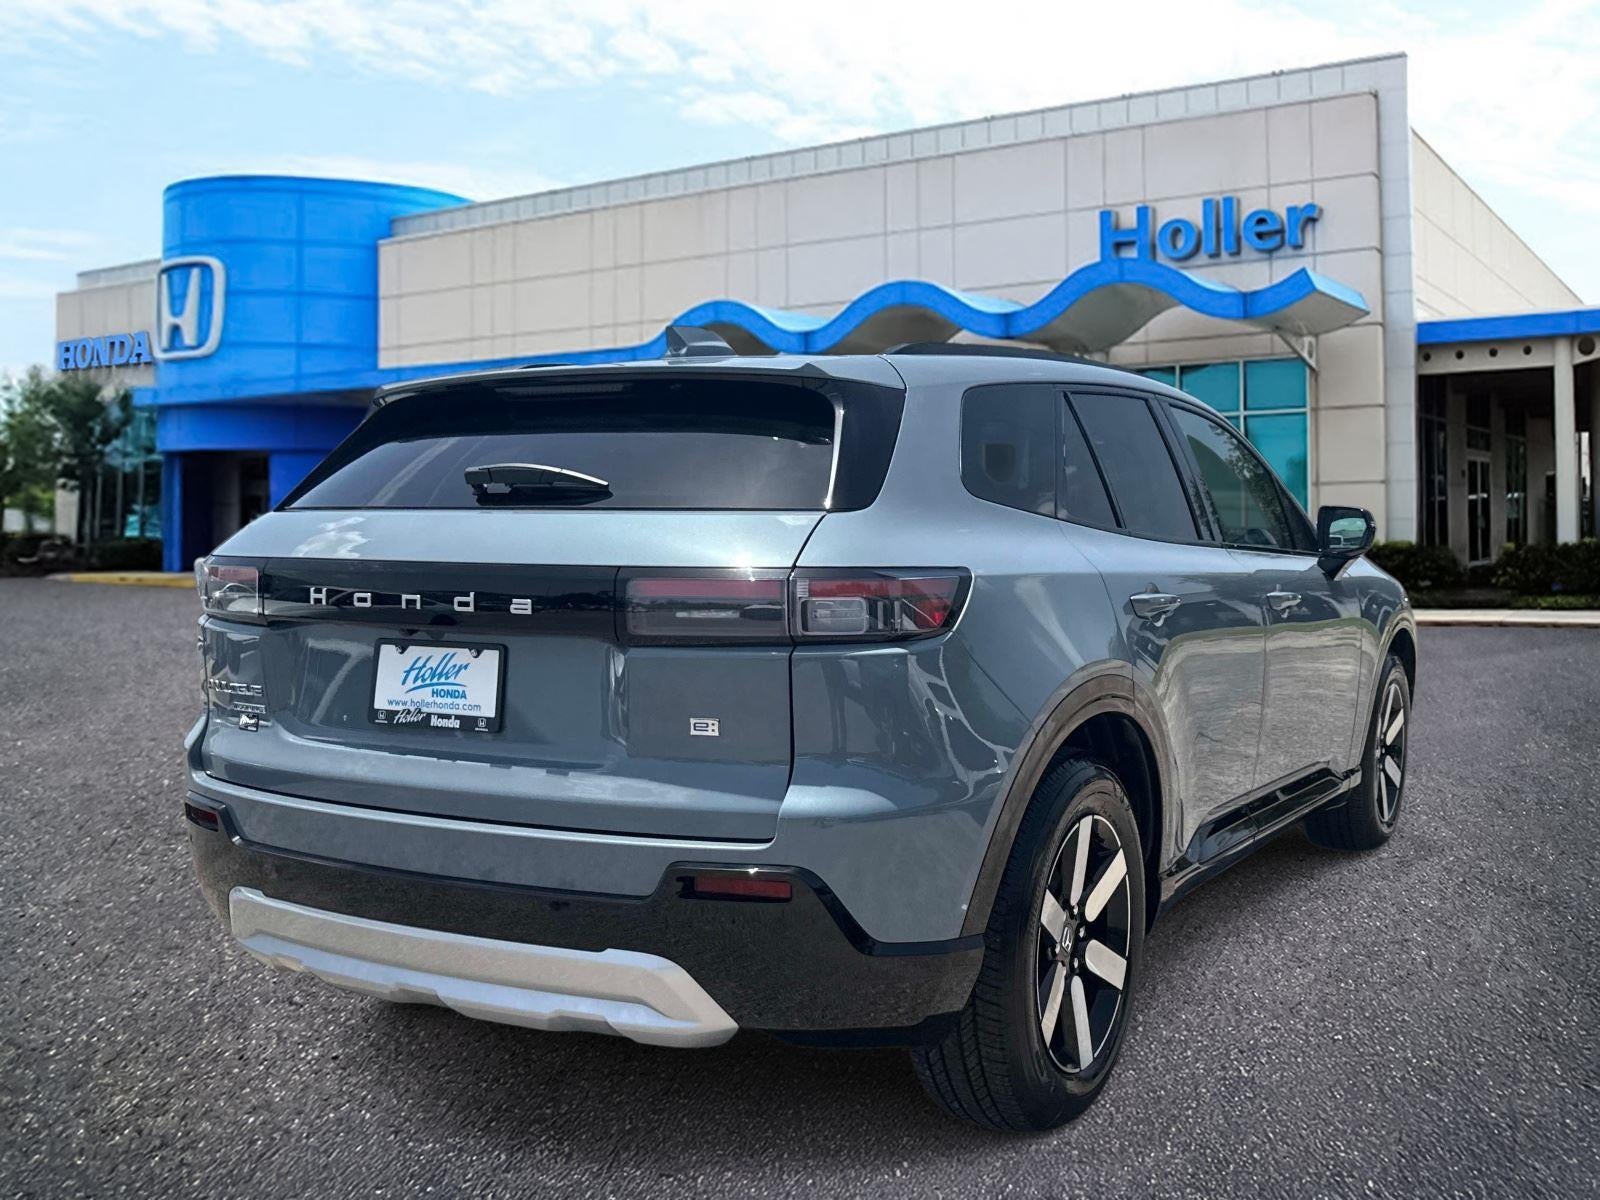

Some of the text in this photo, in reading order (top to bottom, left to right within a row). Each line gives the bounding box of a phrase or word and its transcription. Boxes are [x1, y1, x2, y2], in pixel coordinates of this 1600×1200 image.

[1099, 195, 1323, 262] Holler
[57, 330, 152, 371] HONDA
[309, 586, 533, 615] Honda
[401, 652, 470, 686] Holler
[387, 697, 482, 712] www.hollerhonda.com
[431, 687, 467, 700] HONDA
[393, 708, 460, 728] Holler Honda
